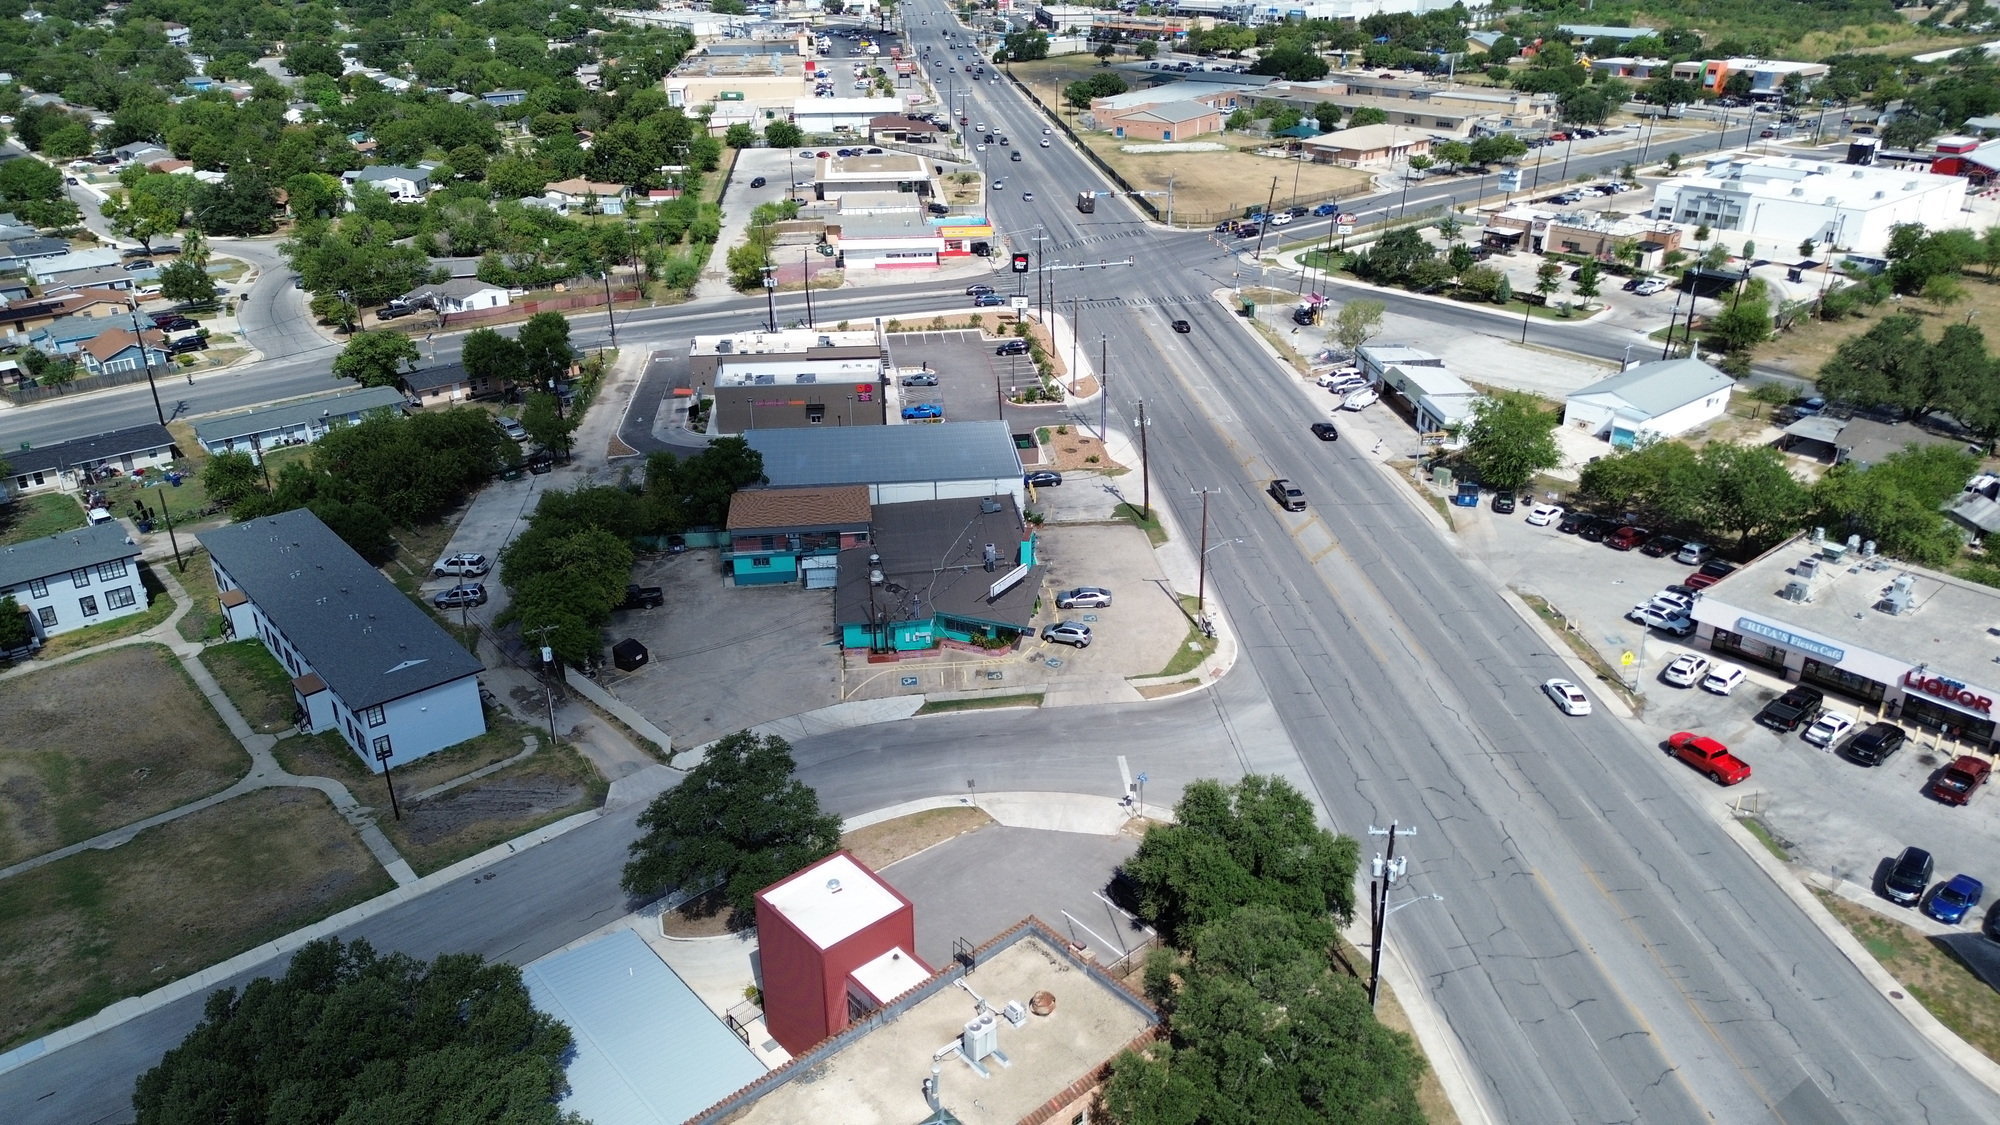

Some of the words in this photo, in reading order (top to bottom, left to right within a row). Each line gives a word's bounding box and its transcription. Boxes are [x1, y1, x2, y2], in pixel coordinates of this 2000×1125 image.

[1747, 621, 1789, 642] RITA'S
[1790, 636, 1818, 653] Fiesta
[1820, 646, 1842, 660] Café
[1904, 671, 1993, 714] LIQUOR
